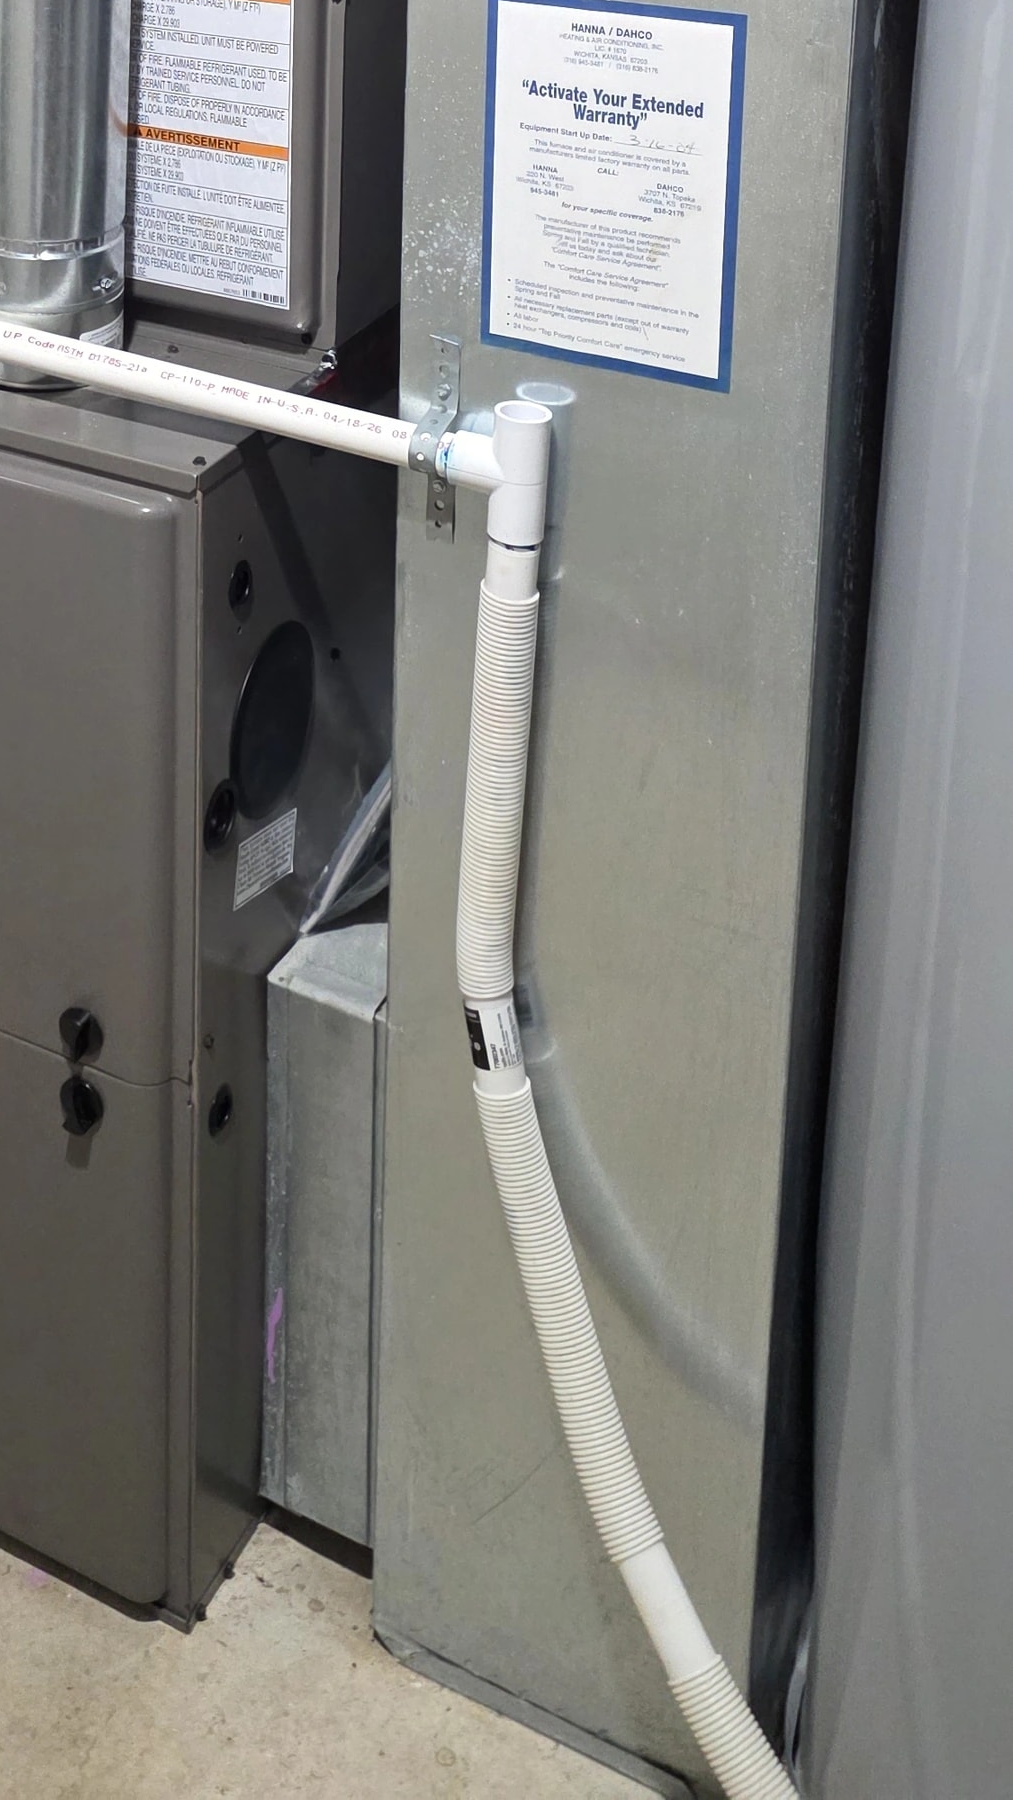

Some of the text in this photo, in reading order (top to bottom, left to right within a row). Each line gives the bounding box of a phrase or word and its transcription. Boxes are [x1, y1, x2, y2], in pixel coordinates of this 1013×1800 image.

[571, 22, 605, 34] HANNA
[616, 28, 652, 40] DAHCO
[521, 78, 704, 118] “Activate Your Extended
[573, 103, 647, 131] Warranty”
[145, 127, 240, 152] AVERTISSEMENT
[519, 122, 612, 142] Equipment Start Up Date:
[532, 164, 557, 173] HANNA
[597, 167, 618, 176] CALL:
[656, 183, 684, 193] DAHCO
[572, 204, 587, 213] your
[589, 206, 617, 217] specific
[619, 211, 653, 222] coverage.
[28, 336, 55, 349] Code
[57, 344, 84, 358] ASTM
[221, 386, 249, 400] MADE
[257, 395, 272, 404] IN
